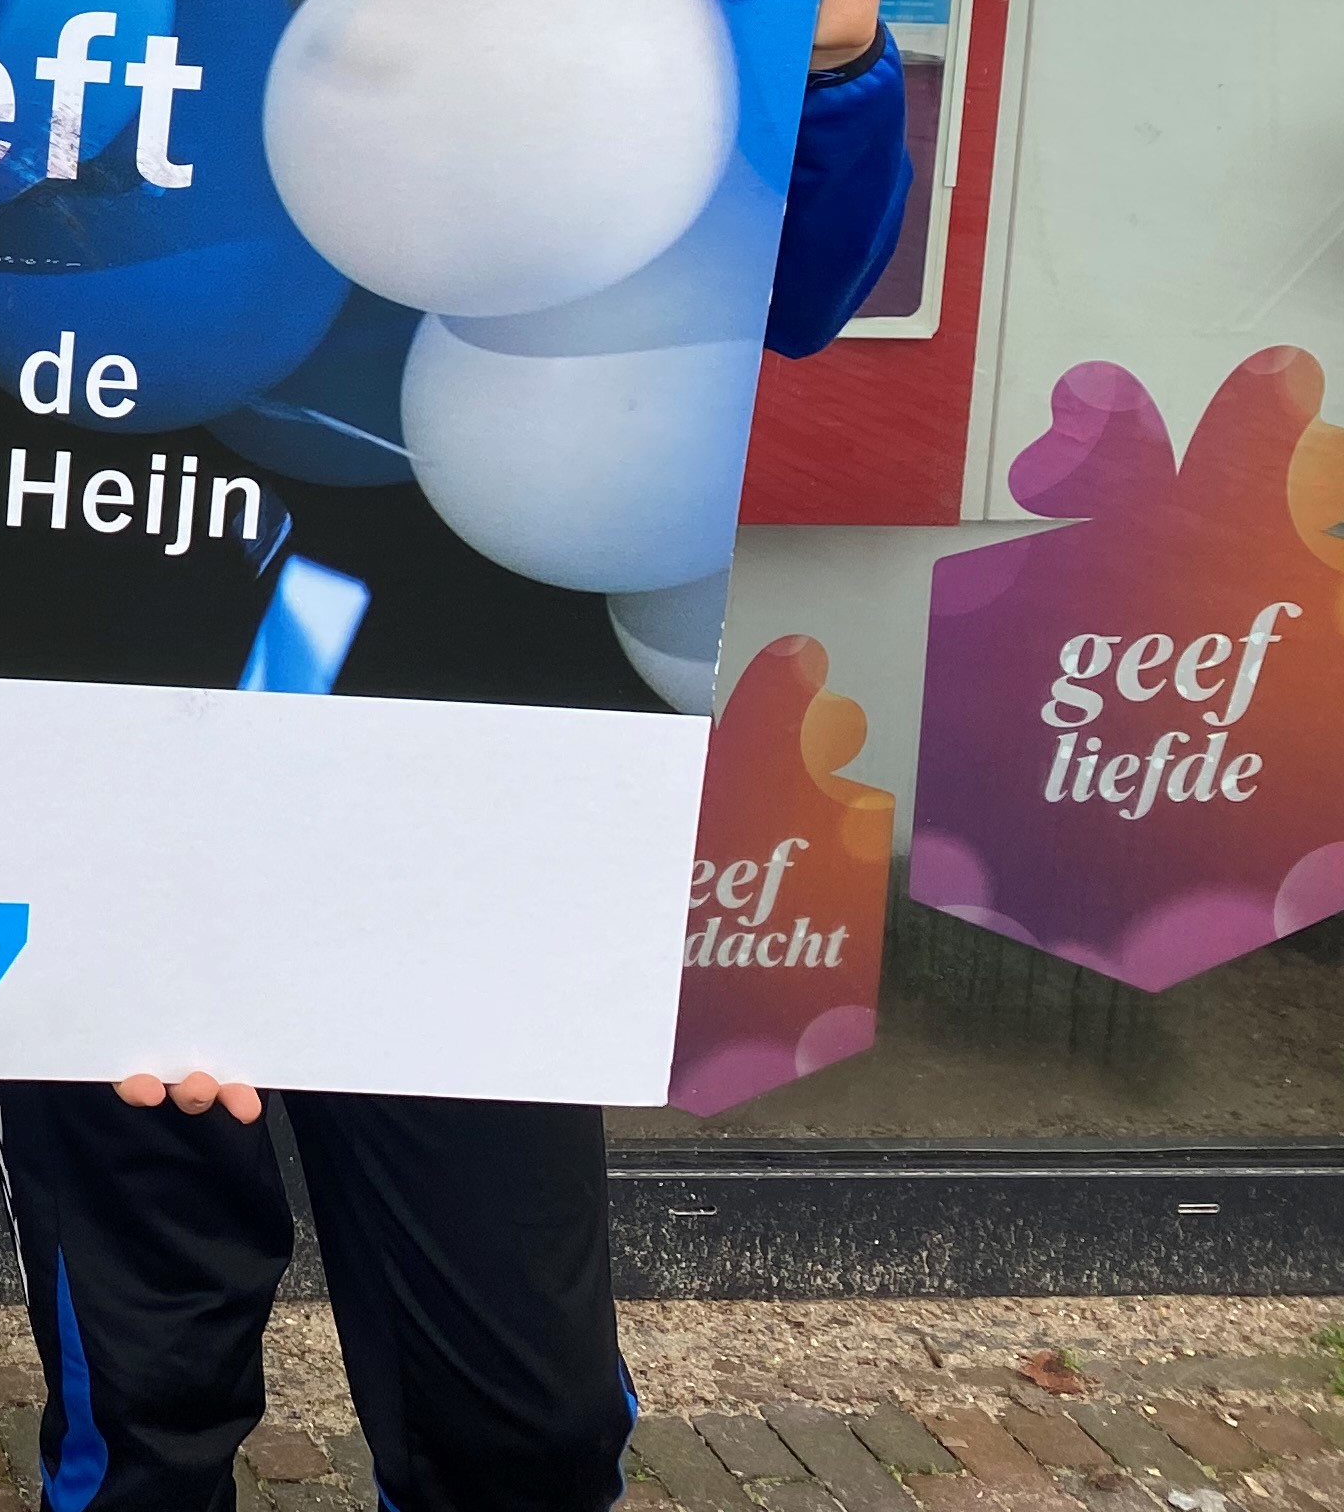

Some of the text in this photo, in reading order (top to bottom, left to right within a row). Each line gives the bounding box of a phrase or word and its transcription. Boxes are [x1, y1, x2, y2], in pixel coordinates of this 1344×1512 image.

[17, 330, 141, 420] de
[3, 446, 264, 557] Heijn
[1041, 602, 1303, 729] geef
[1043, 732, 1264, 821] liefde
[689, 837, 811, 928] eef
[682, 916, 850, 969] dacht
